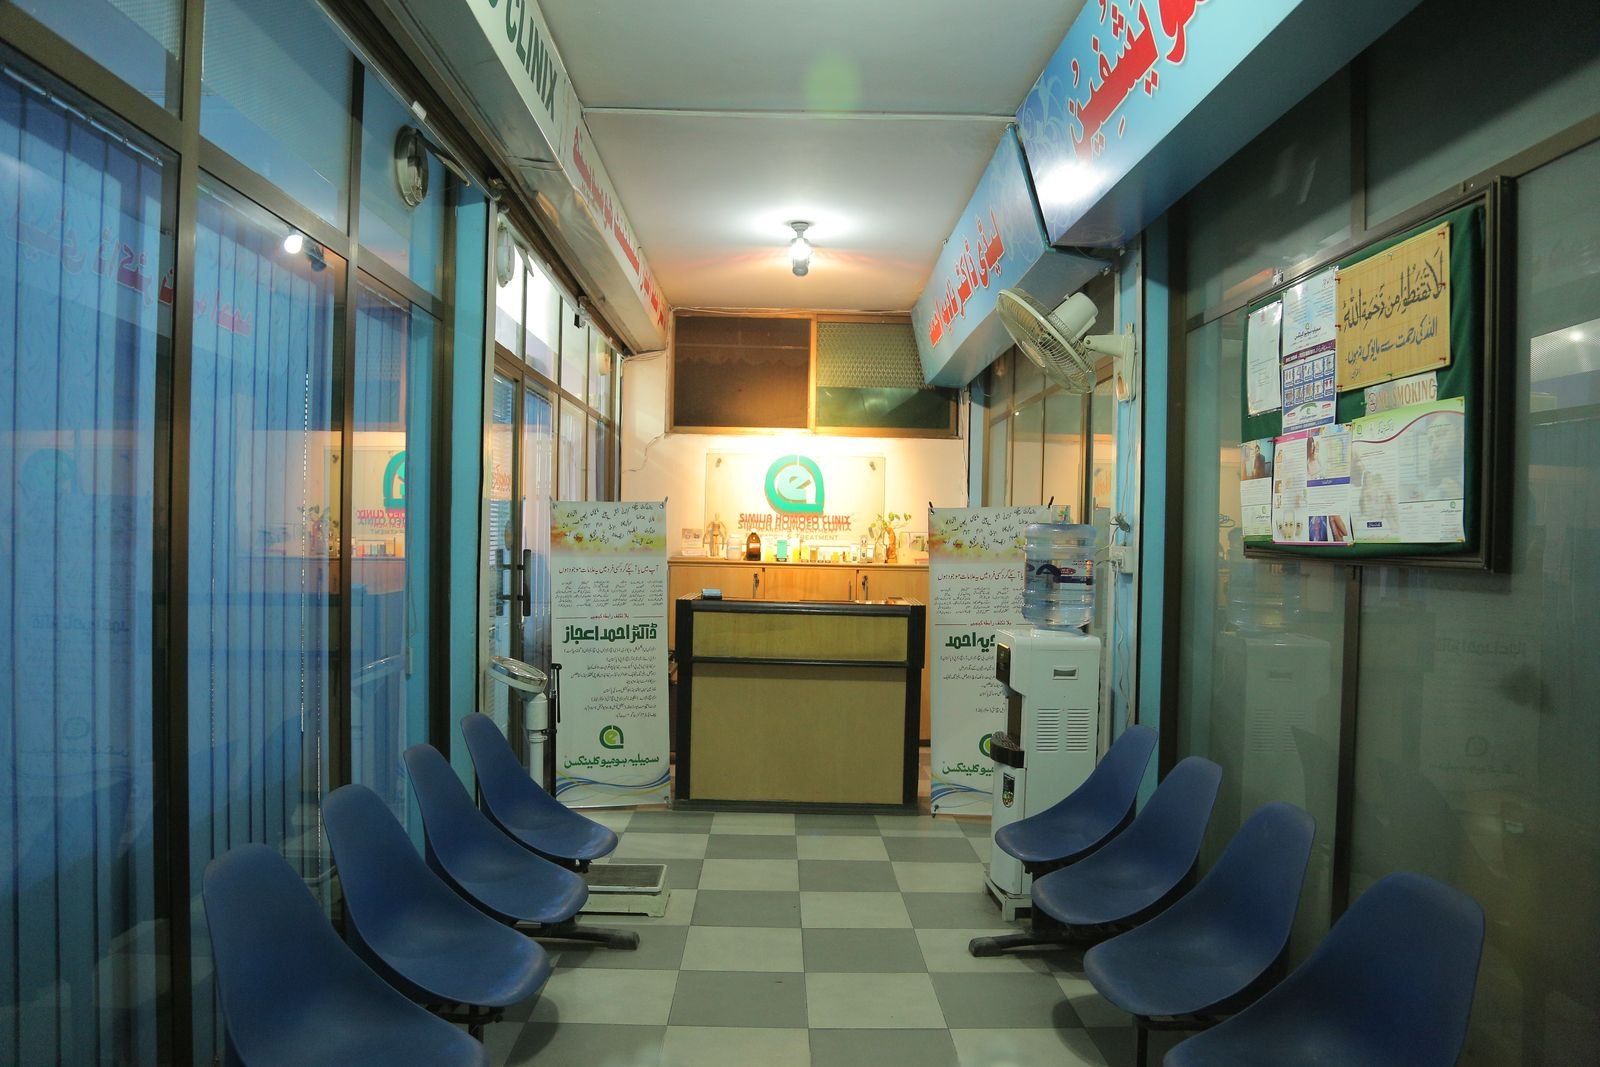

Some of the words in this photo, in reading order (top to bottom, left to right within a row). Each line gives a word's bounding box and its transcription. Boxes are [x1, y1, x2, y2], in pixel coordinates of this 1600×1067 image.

[505, 0, 558, 122] CLINIX
[1392, 378, 1436, 406] SMOKING
[562, 625, 598, 644] اعجاز
[600, 624, 629, 642] احمد
[630, 623, 658, 643] ڈاکٹر
[945, 632, 976, 649] احمد
